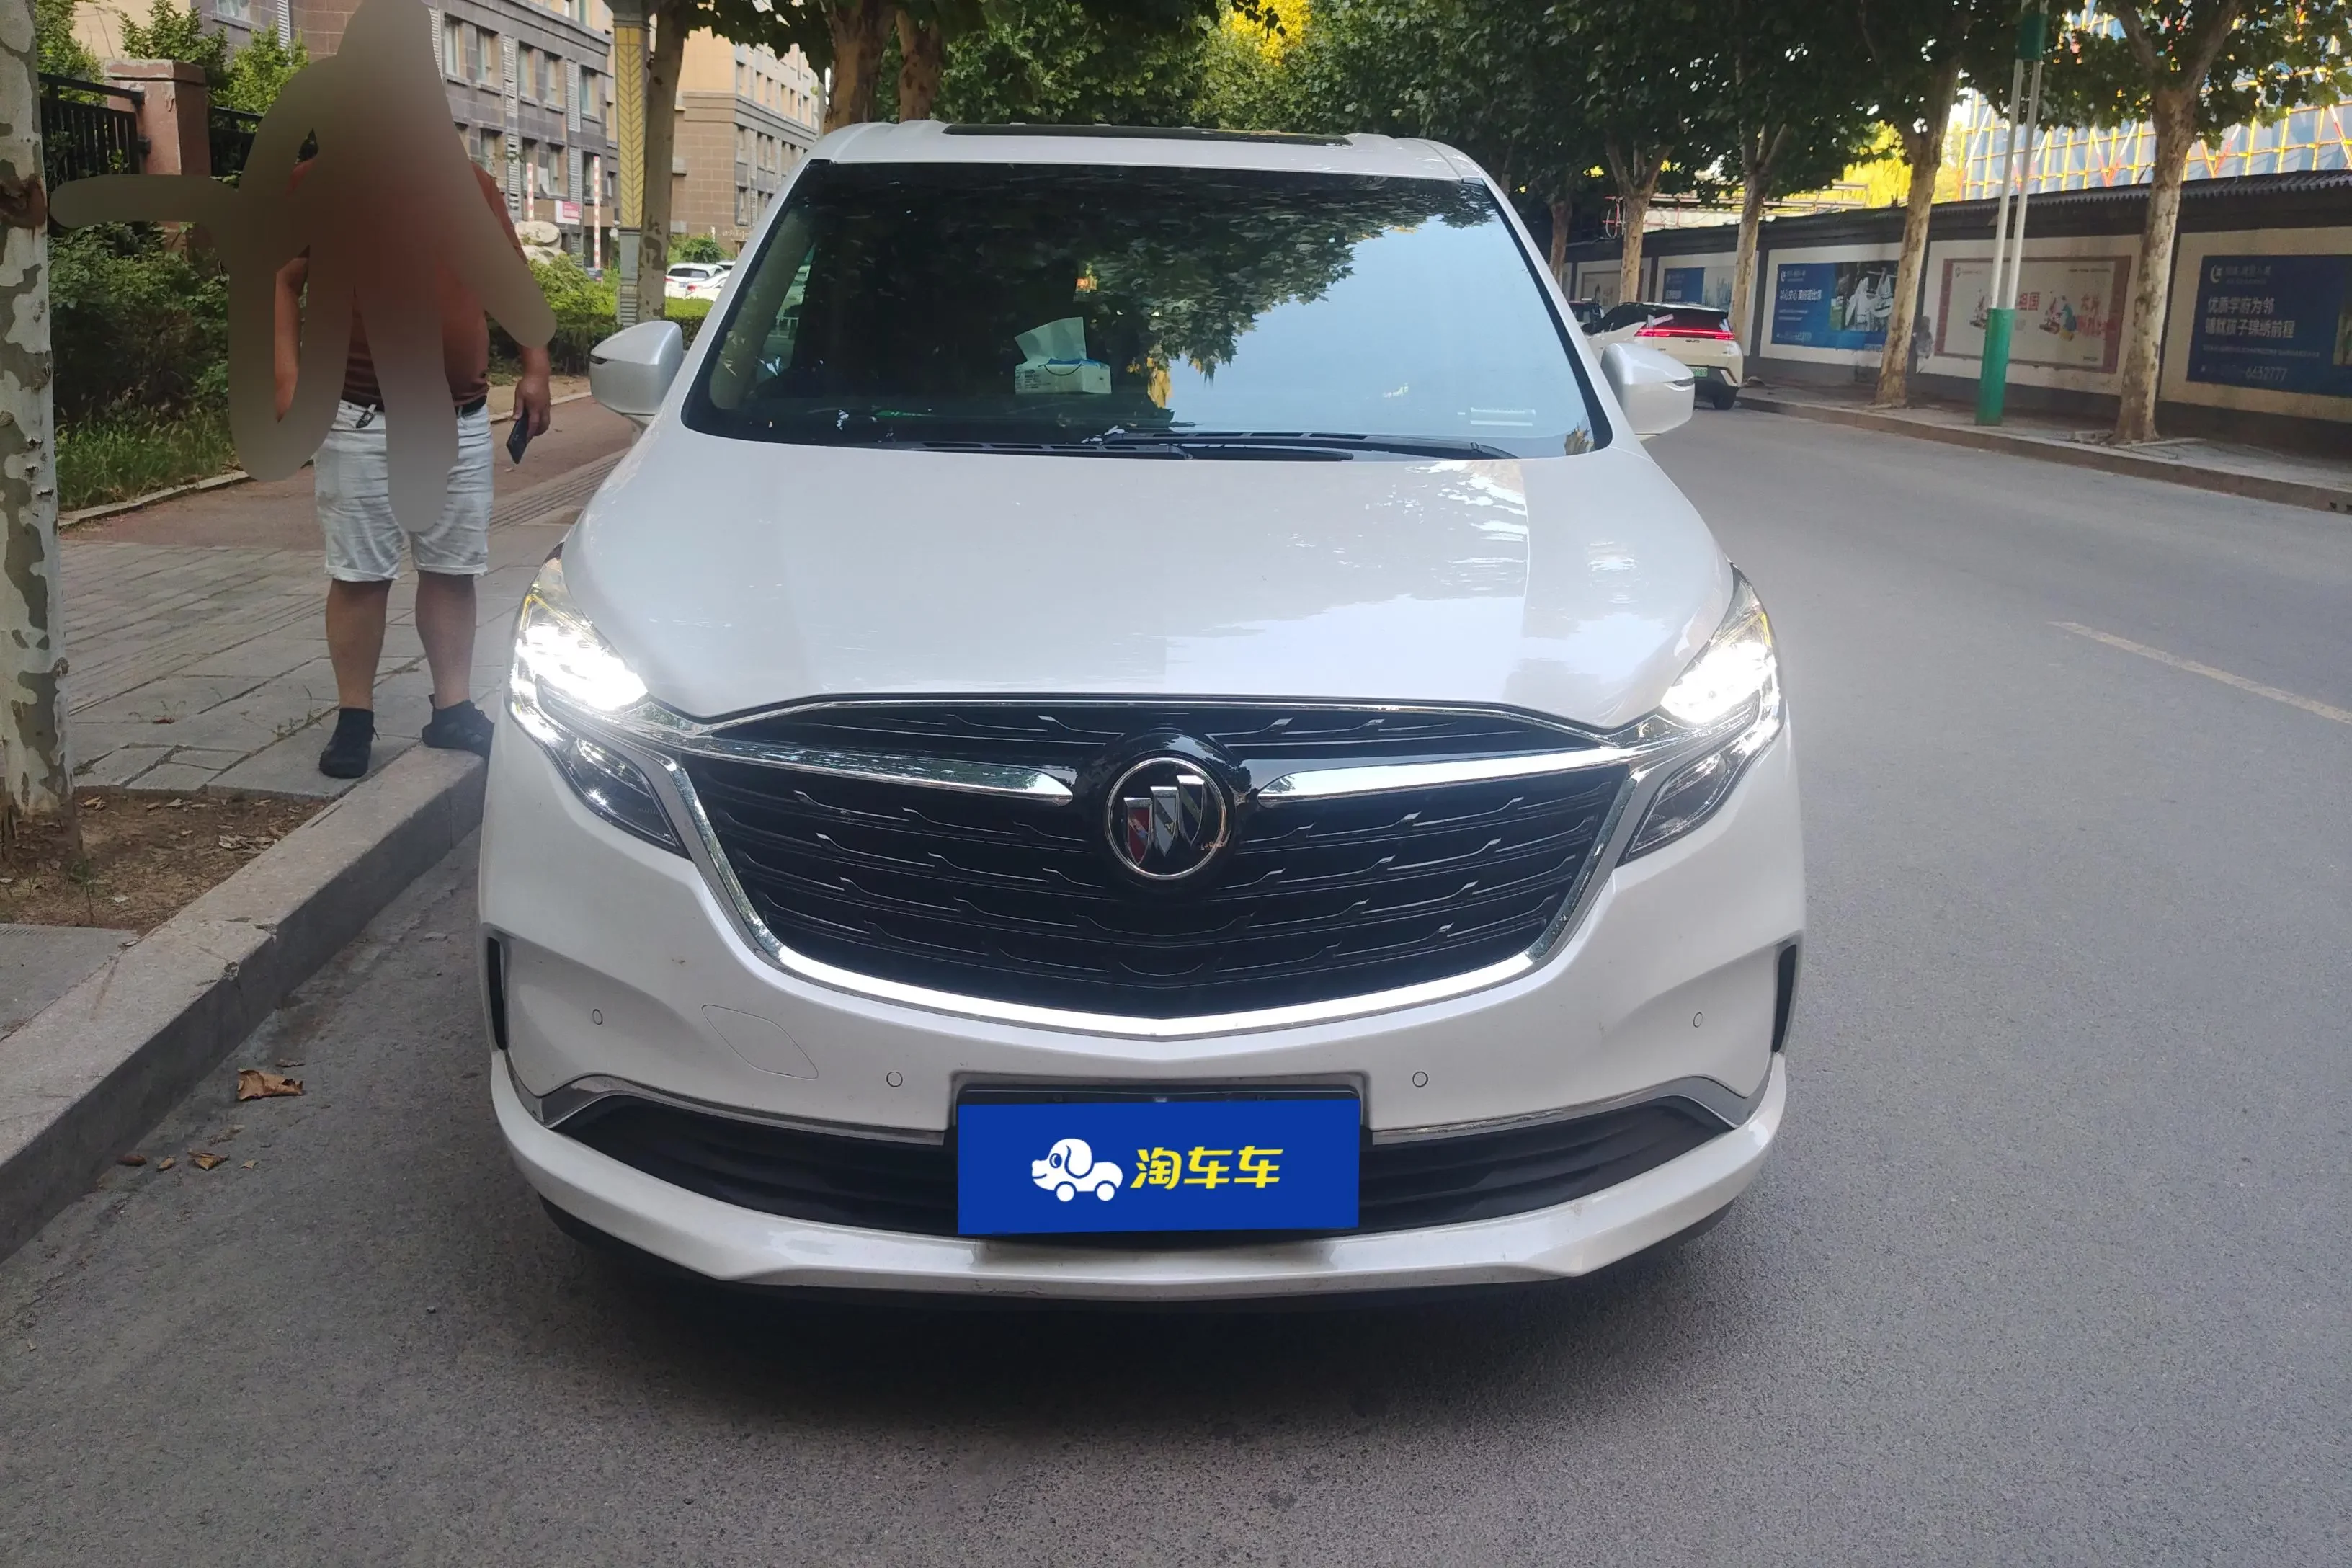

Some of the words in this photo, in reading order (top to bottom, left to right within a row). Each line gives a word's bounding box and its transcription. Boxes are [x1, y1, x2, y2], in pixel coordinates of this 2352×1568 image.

[2207, 295, 2275, 315] 优质学府为邻
